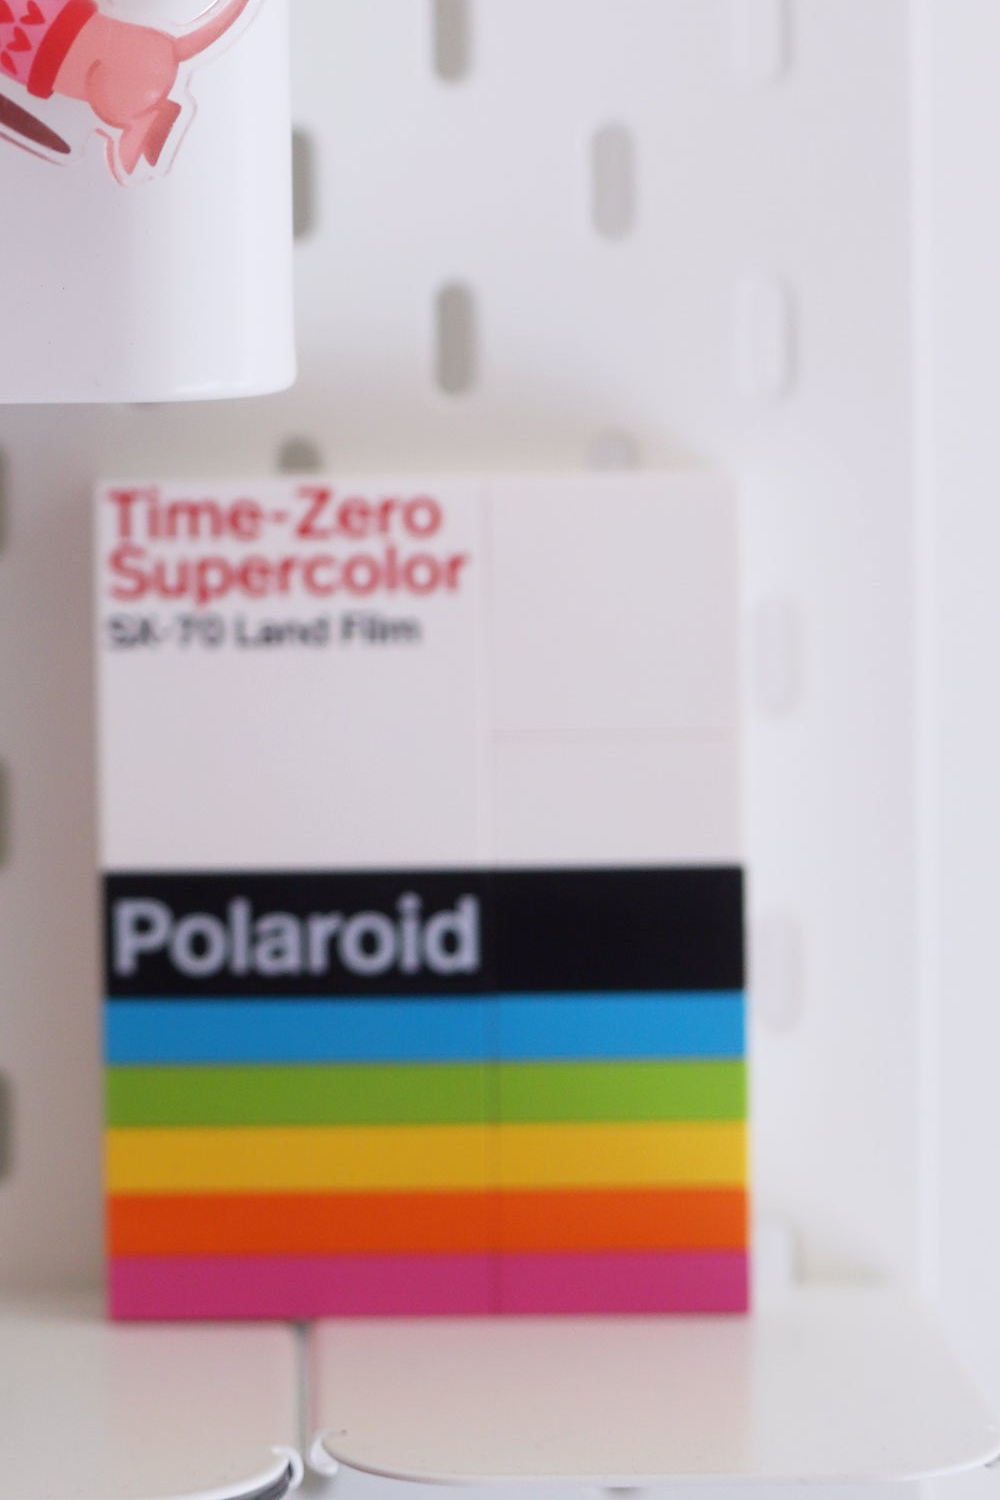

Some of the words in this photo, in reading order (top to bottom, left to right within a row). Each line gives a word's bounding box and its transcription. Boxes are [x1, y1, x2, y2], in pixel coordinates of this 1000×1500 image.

[106, 484, 443, 542] Time-Zero
[107, 544, 467, 607] Supercolor
[107, 613, 226, 649] SX-70
[234, 612, 329, 647] Land
[340, 609, 420, 643] Film
[112, 891, 481, 977] Polaroid
